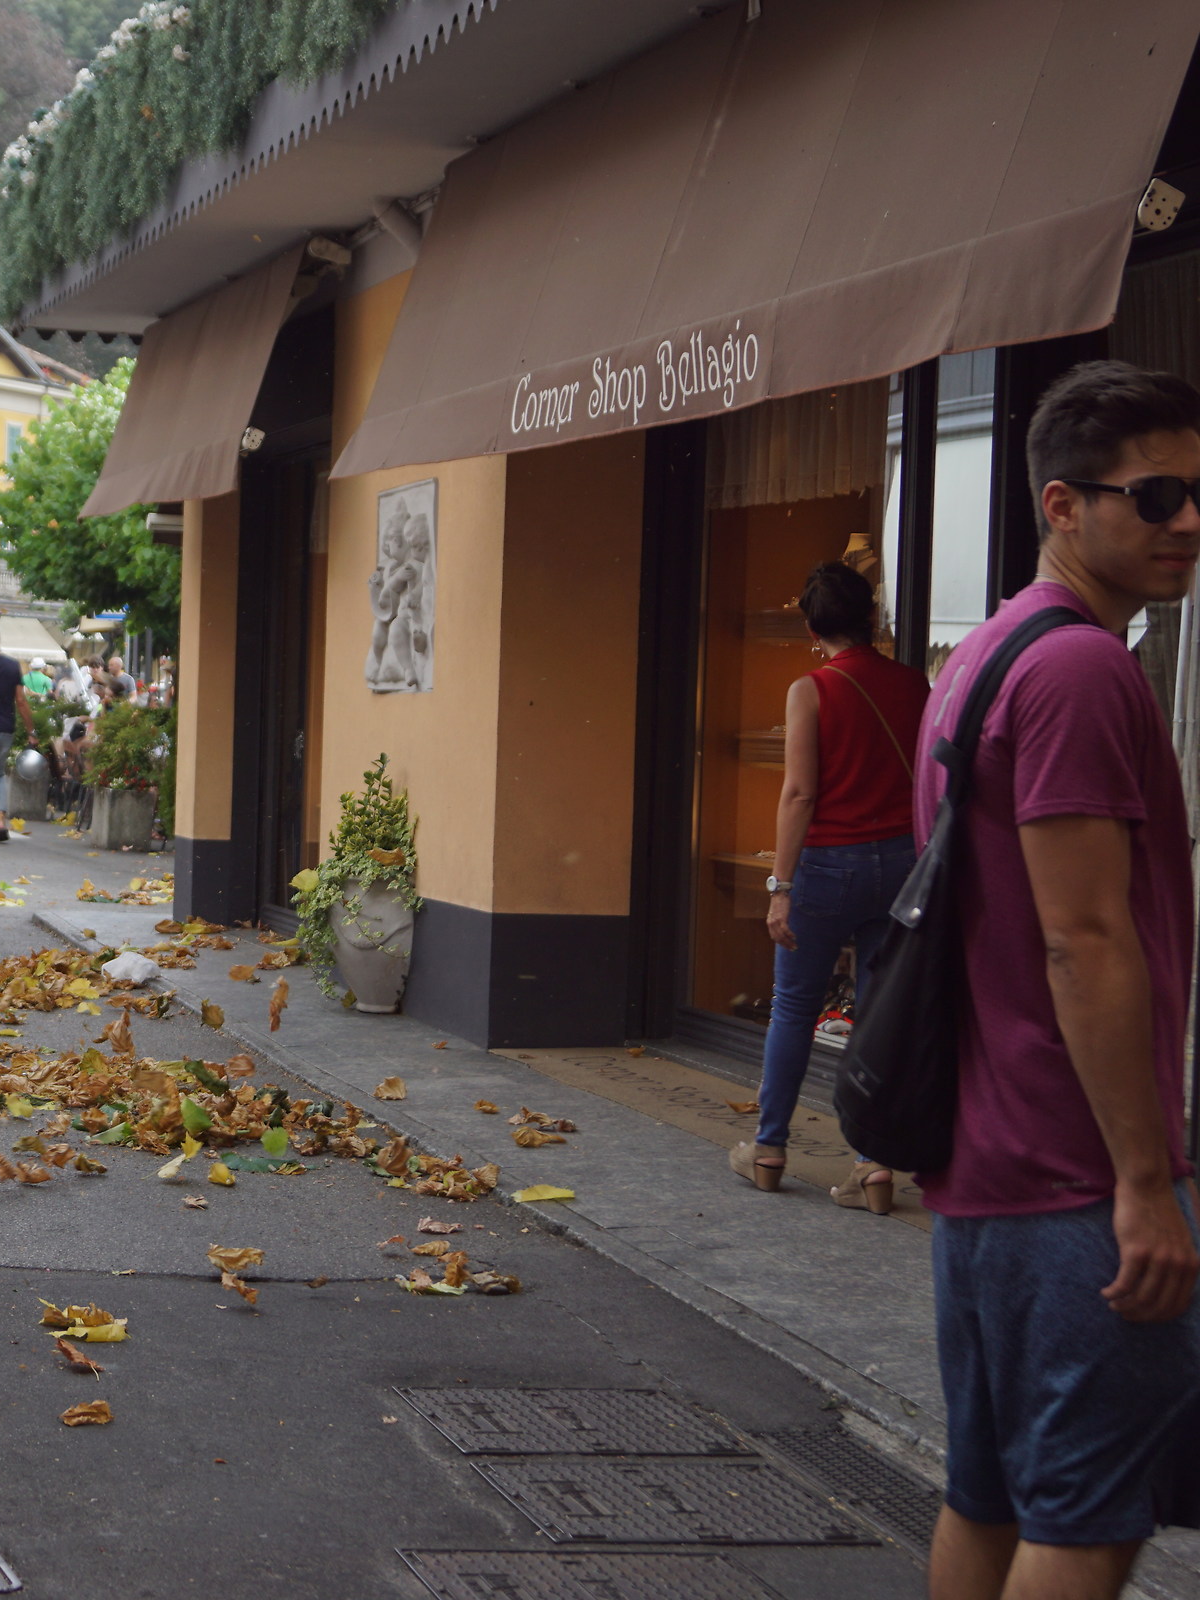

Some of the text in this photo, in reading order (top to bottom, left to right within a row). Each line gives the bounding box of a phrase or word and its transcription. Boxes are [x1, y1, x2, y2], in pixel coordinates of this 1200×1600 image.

[511, 319, 759, 434] Corner Shop Bellagio
